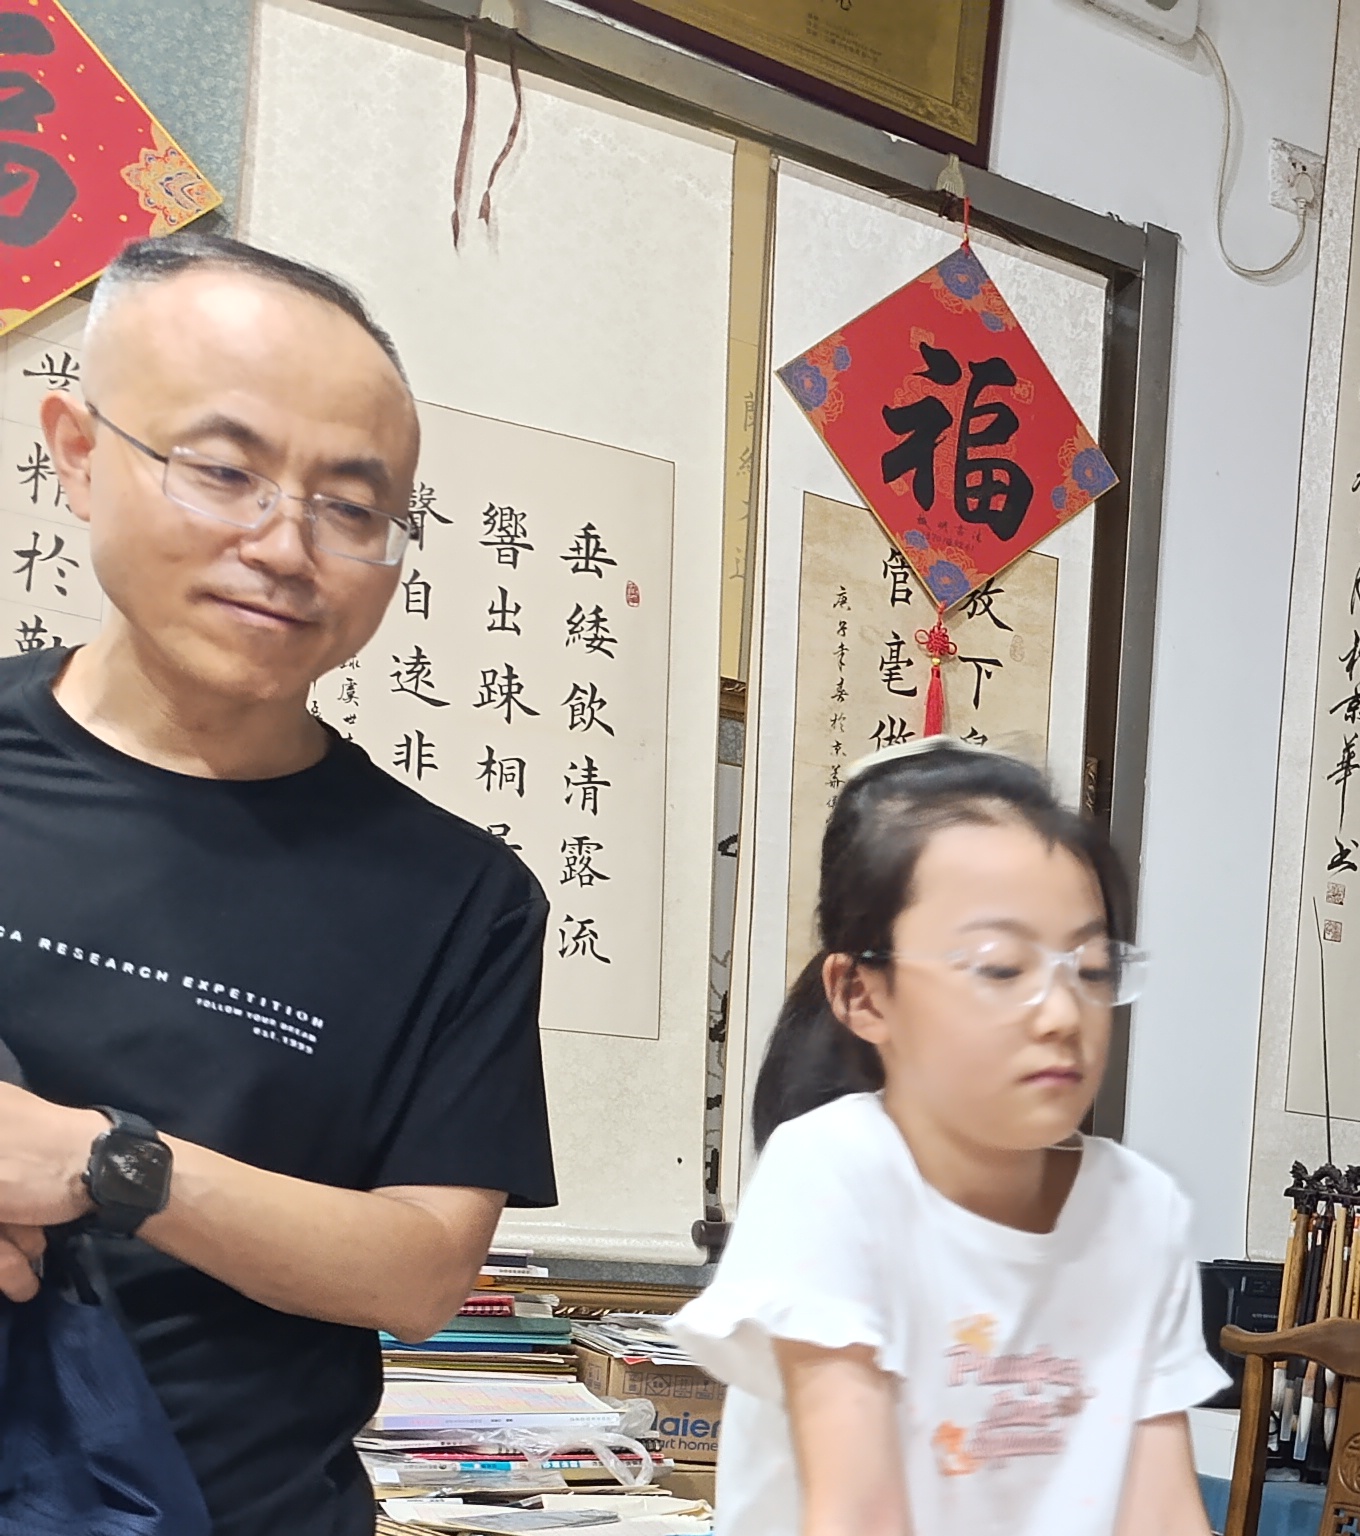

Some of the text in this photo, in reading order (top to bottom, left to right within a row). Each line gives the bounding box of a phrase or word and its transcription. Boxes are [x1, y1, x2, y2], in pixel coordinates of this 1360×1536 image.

[880, 342, 1034, 541] 福
[38, 937, 169, 983] RESEARCH
[182, 975, 324, 1029] EXPETITION
